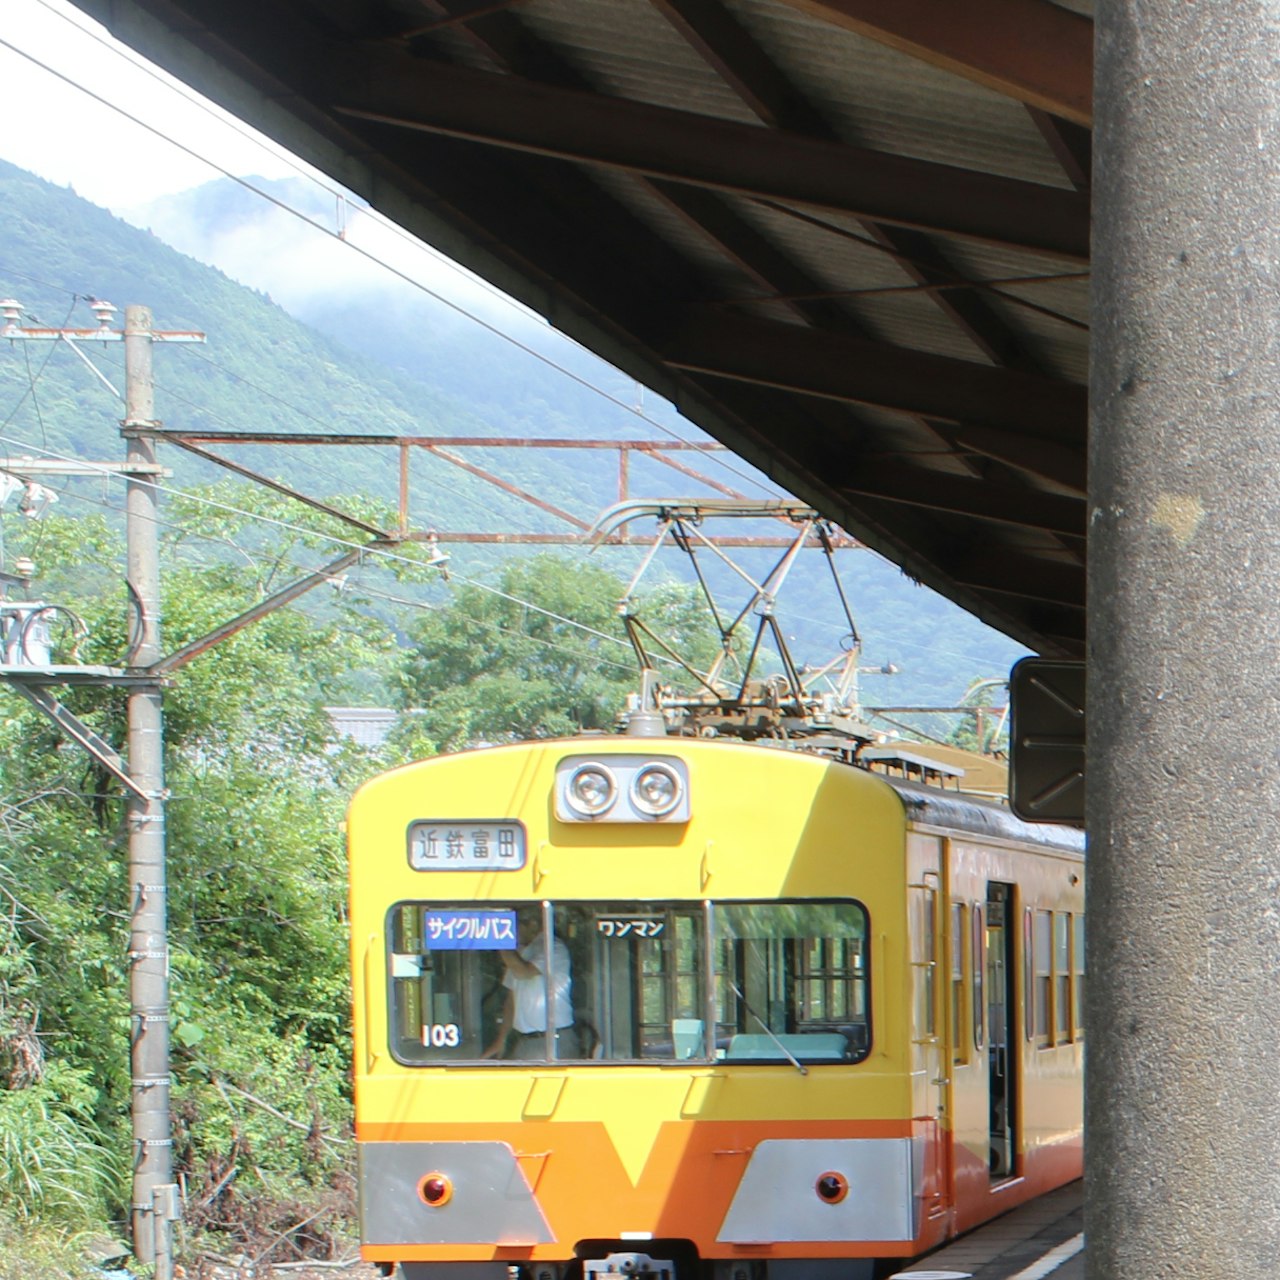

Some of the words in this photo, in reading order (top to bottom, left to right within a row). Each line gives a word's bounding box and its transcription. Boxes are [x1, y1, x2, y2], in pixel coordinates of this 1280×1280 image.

[420, 829, 514, 859] 近鉄富田
[427, 917, 515, 940] サイクルバス
[597, 920, 664, 937] ワンマン
[422, 1023, 460, 1047] 103
